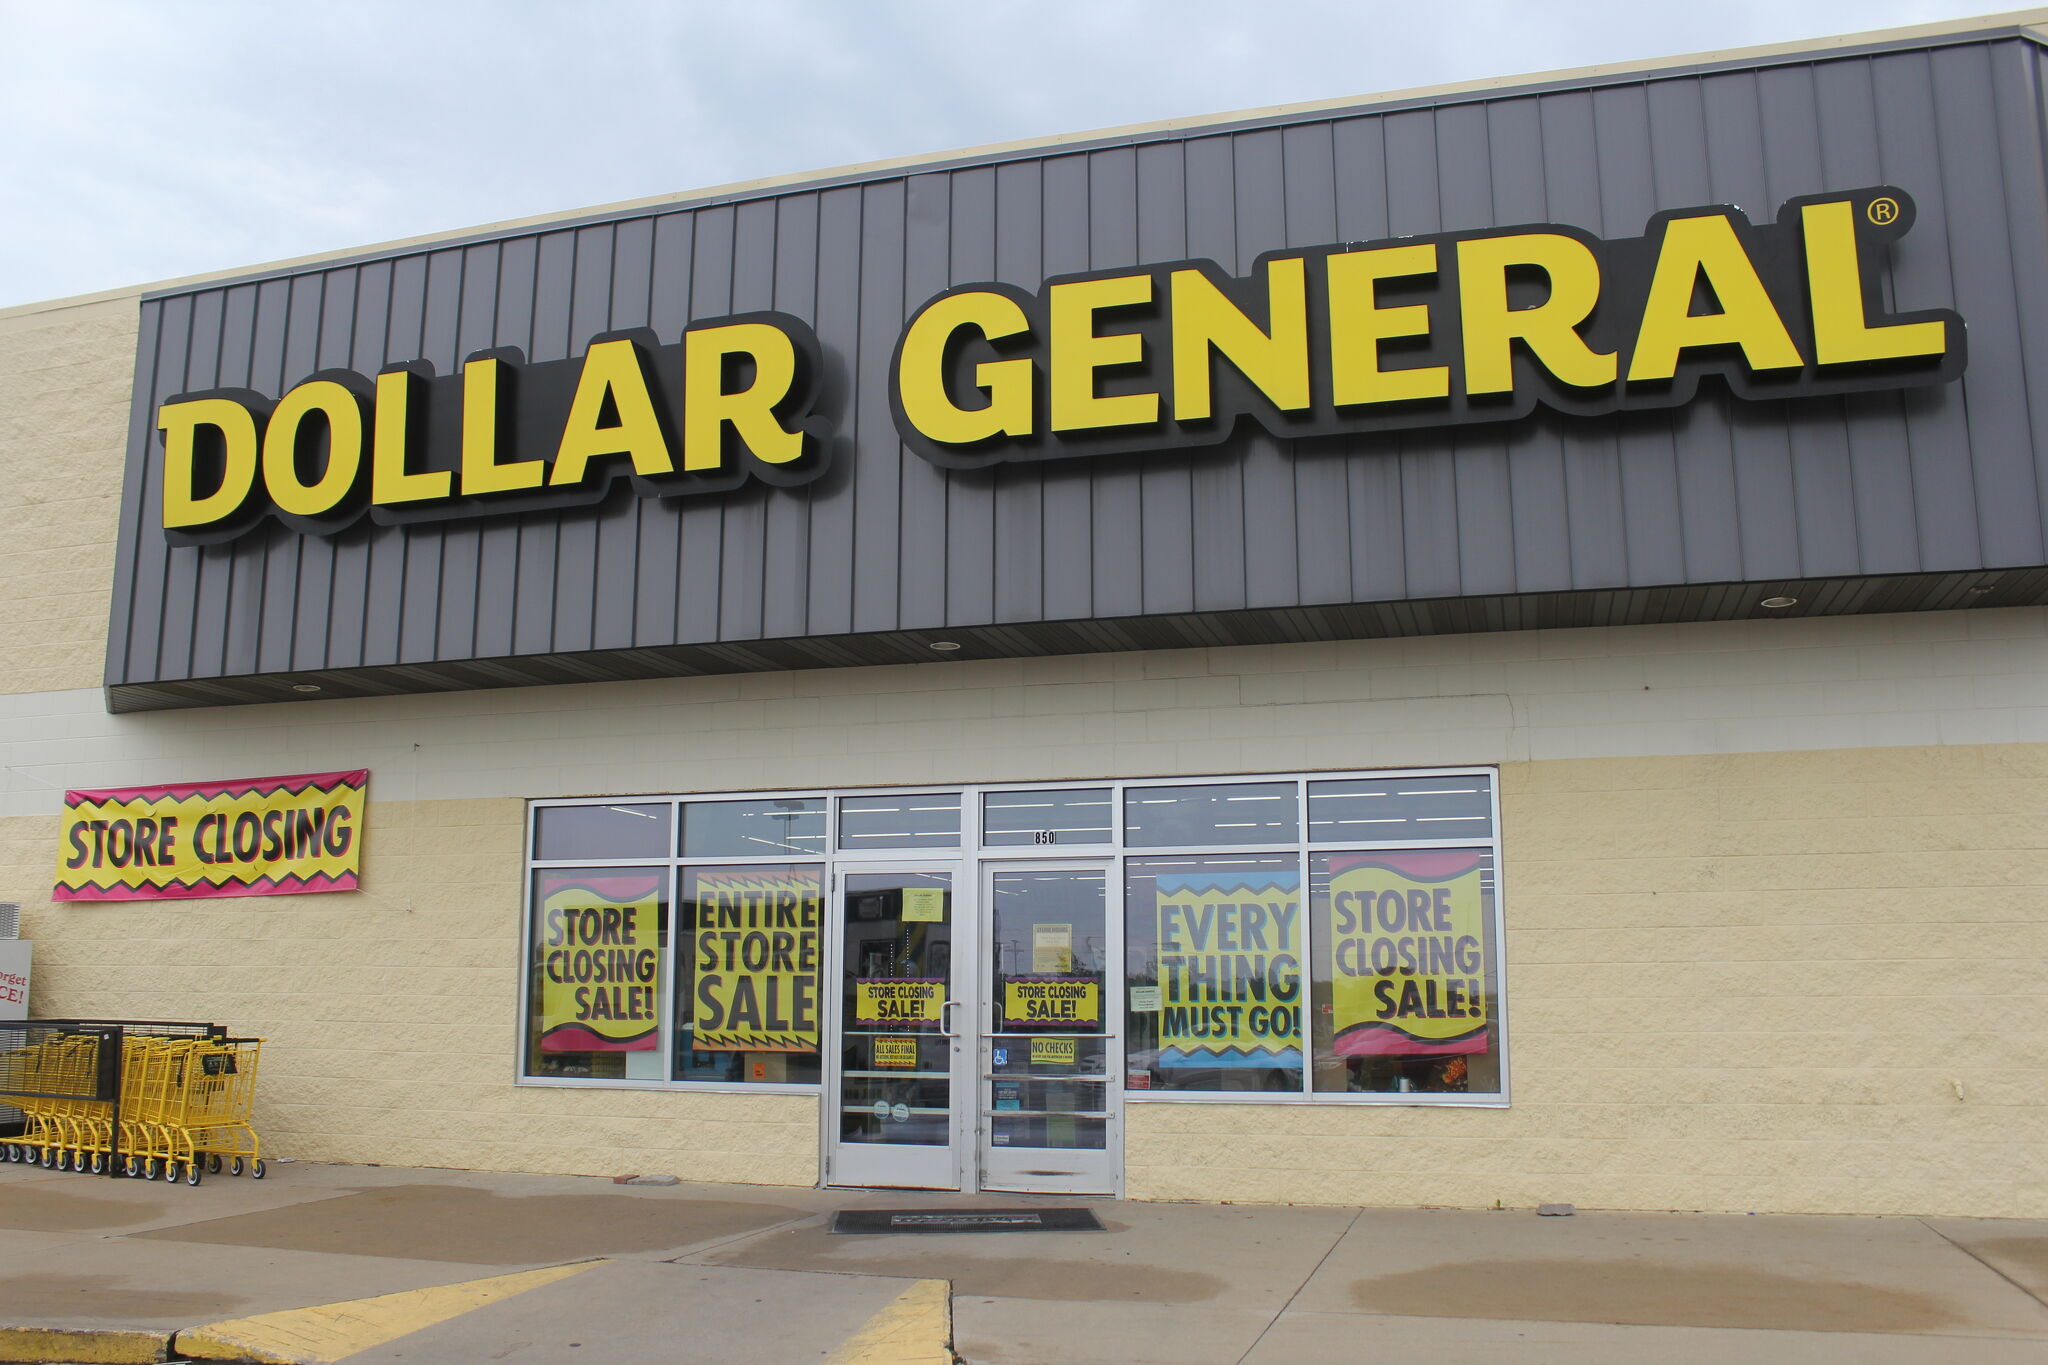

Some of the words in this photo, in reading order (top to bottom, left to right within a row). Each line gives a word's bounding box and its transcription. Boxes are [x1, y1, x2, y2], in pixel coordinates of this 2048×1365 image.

[157, 322, 805, 530] DOLLAR
[898, 200, 1946, 445] GENERAL
[66, 815, 178, 870] STORE
[192, 804, 353, 864] CLOSING
[1034, 831, 1056, 845] 850
[547, 907, 637, 946] STORE
[699, 889, 817, 928] ENTIRE
[1160, 902, 1298, 951] EVERY
[1334, 888, 1453, 934] STORE
[546, 949, 656, 984] CLOSING
[698, 931, 817, 972] STORE
[1335, 935, 1482, 977] CLOSING
[868, 986, 896, 999] STORE
[898, 986, 934, 998] CLOSING
[1017, 985, 1046, 999] STORE
[1048, 985, 1087, 999] CLOSING
[1162, 954, 1301, 1003] THING
[574, 985, 655, 1020] SALE!
[696, 974, 815, 1032] SALE
[877, 1000, 925, 1018] SALE!
[1026, 1000, 1077, 1018] SALE!
[1374, 979, 1483, 1019] SALE!
[1163, 1005, 1245, 1038] MUST
[1248, 1006, 1301, 1039] GO!
[876, 1045, 885, 1054] ALL
[885, 1045, 901, 1054] SALES
[901, 1045, 915, 1054] FINAL
[1032, 1041, 1044, 1053] NO
[1045, 1042, 1073, 1054] CHECKS
